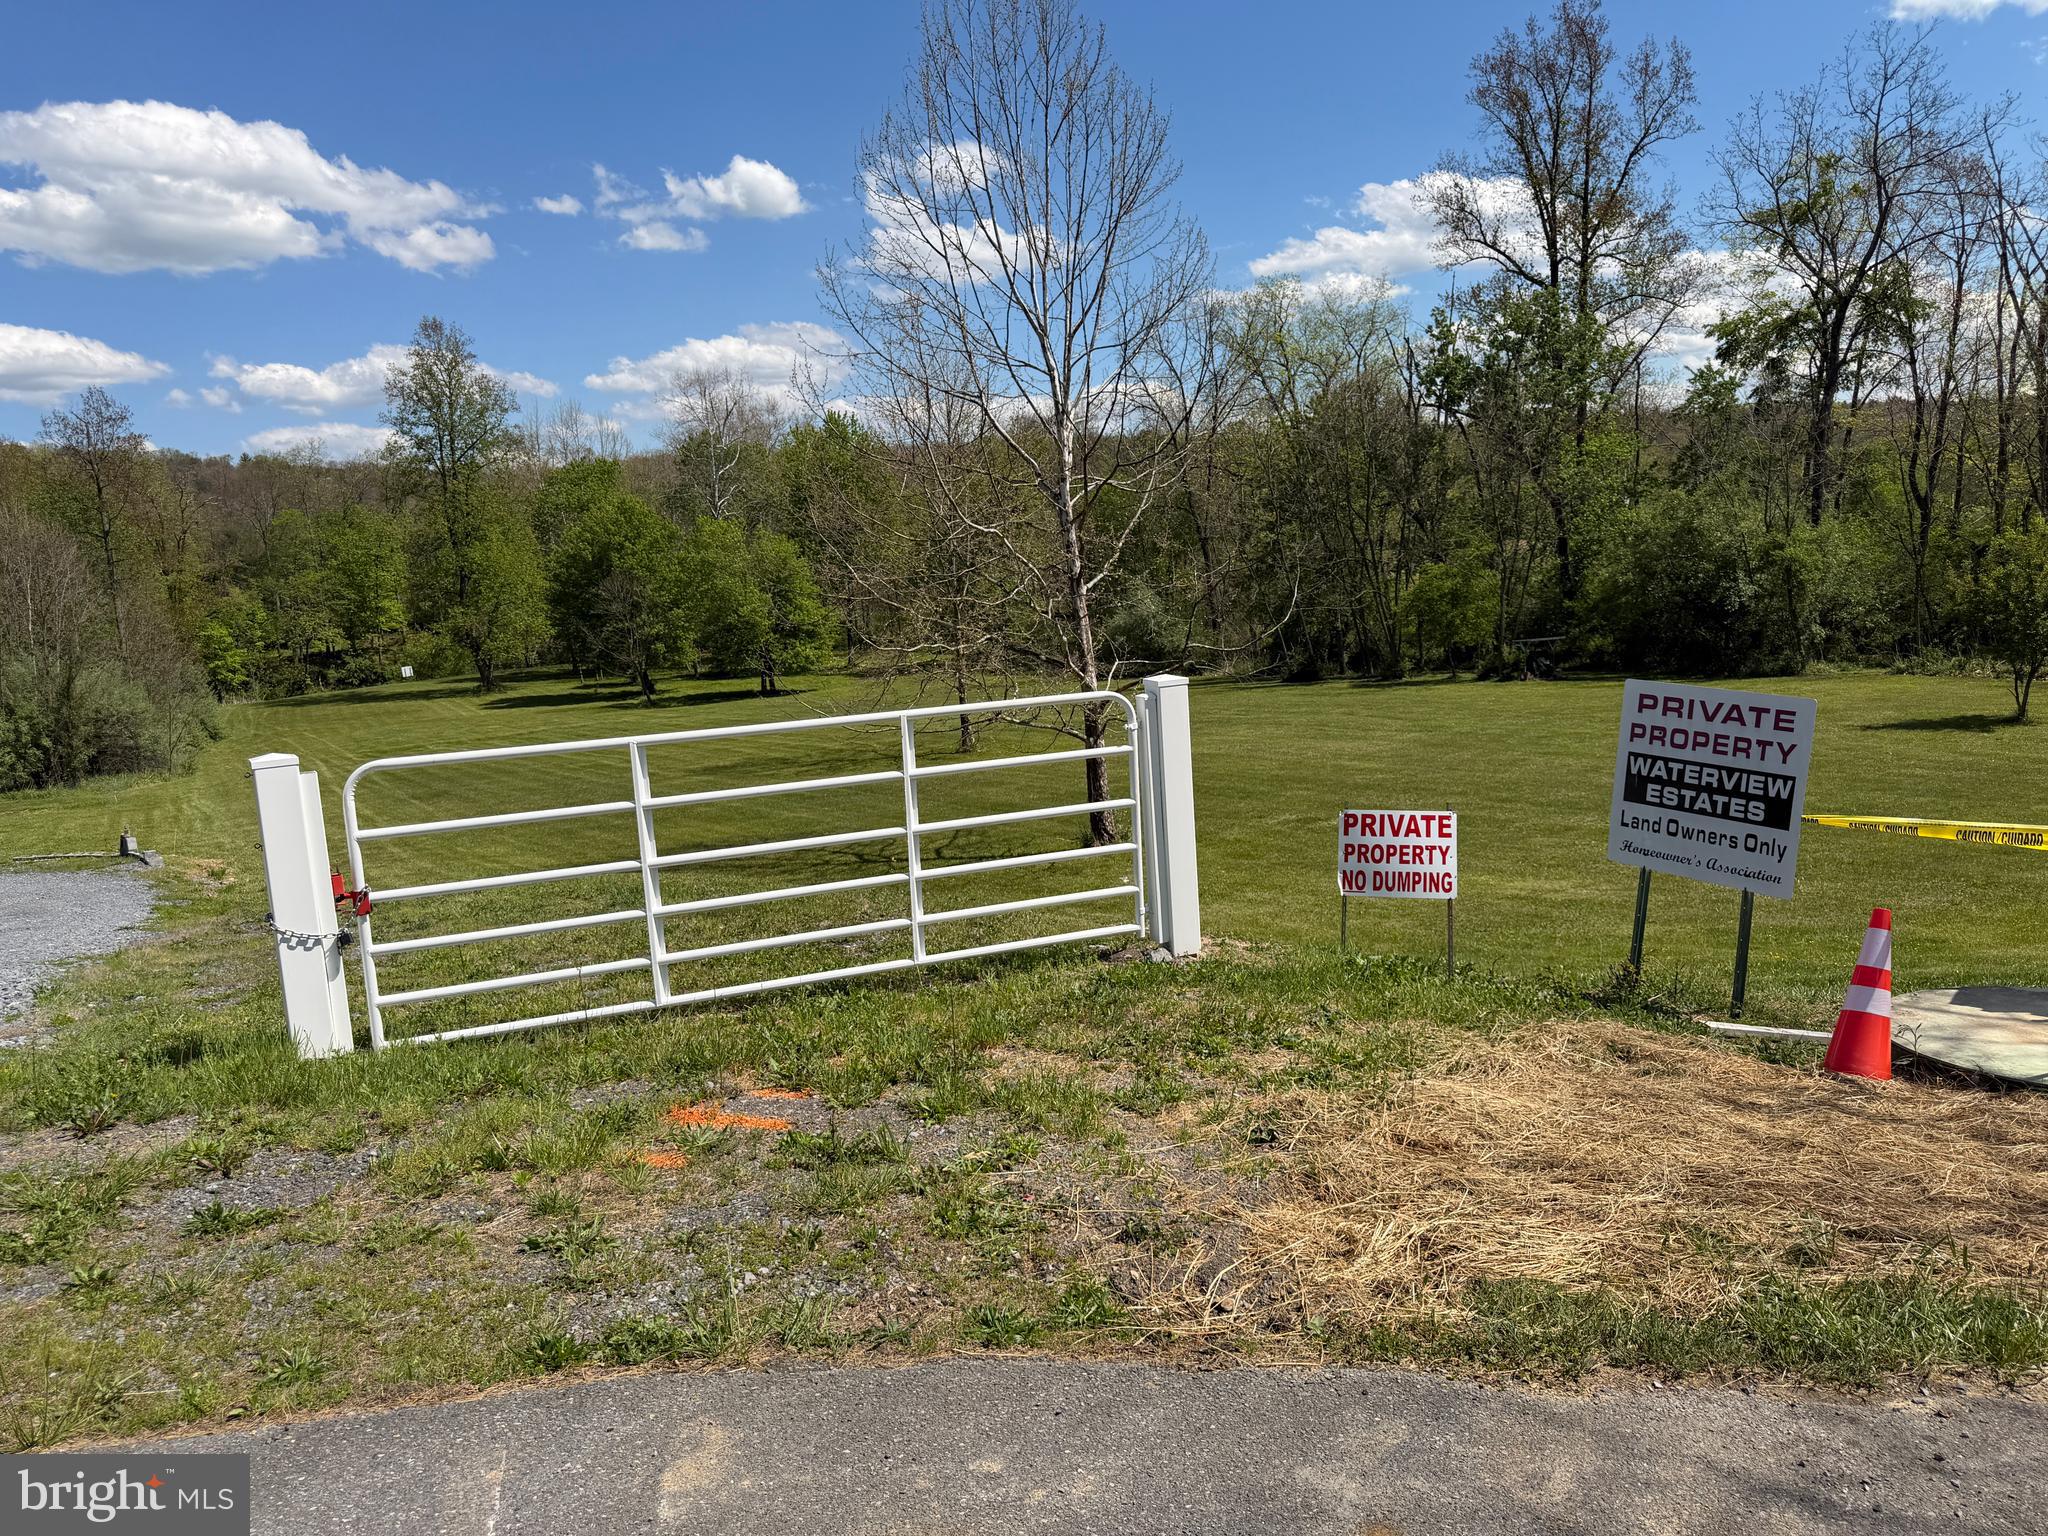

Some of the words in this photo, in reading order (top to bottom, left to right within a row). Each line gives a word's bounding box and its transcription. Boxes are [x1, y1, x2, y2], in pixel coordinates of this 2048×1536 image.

[1637, 693, 1797, 733] PRIVATE
[1629, 722, 1798, 765] PROPERTY
[1629, 755, 1793, 800] WATERVIEW
[1645, 783, 1765, 822] ESTATES
[1343, 813, 1453, 838] PRIVATE
[1620, 809, 1662, 834] Land
[1666, 818, 1739, 849] Owners
[1744, 833, 1788, 864] Only
[1343, 843, 1451, 865] PROPERTY
[1619, 839, 1702, 868] Homeowner's
[1706, 857, 1783, 885] Association
[1342, 869, 1367, 892] NO
[1372, 870, 1453, 894] DUMPING
